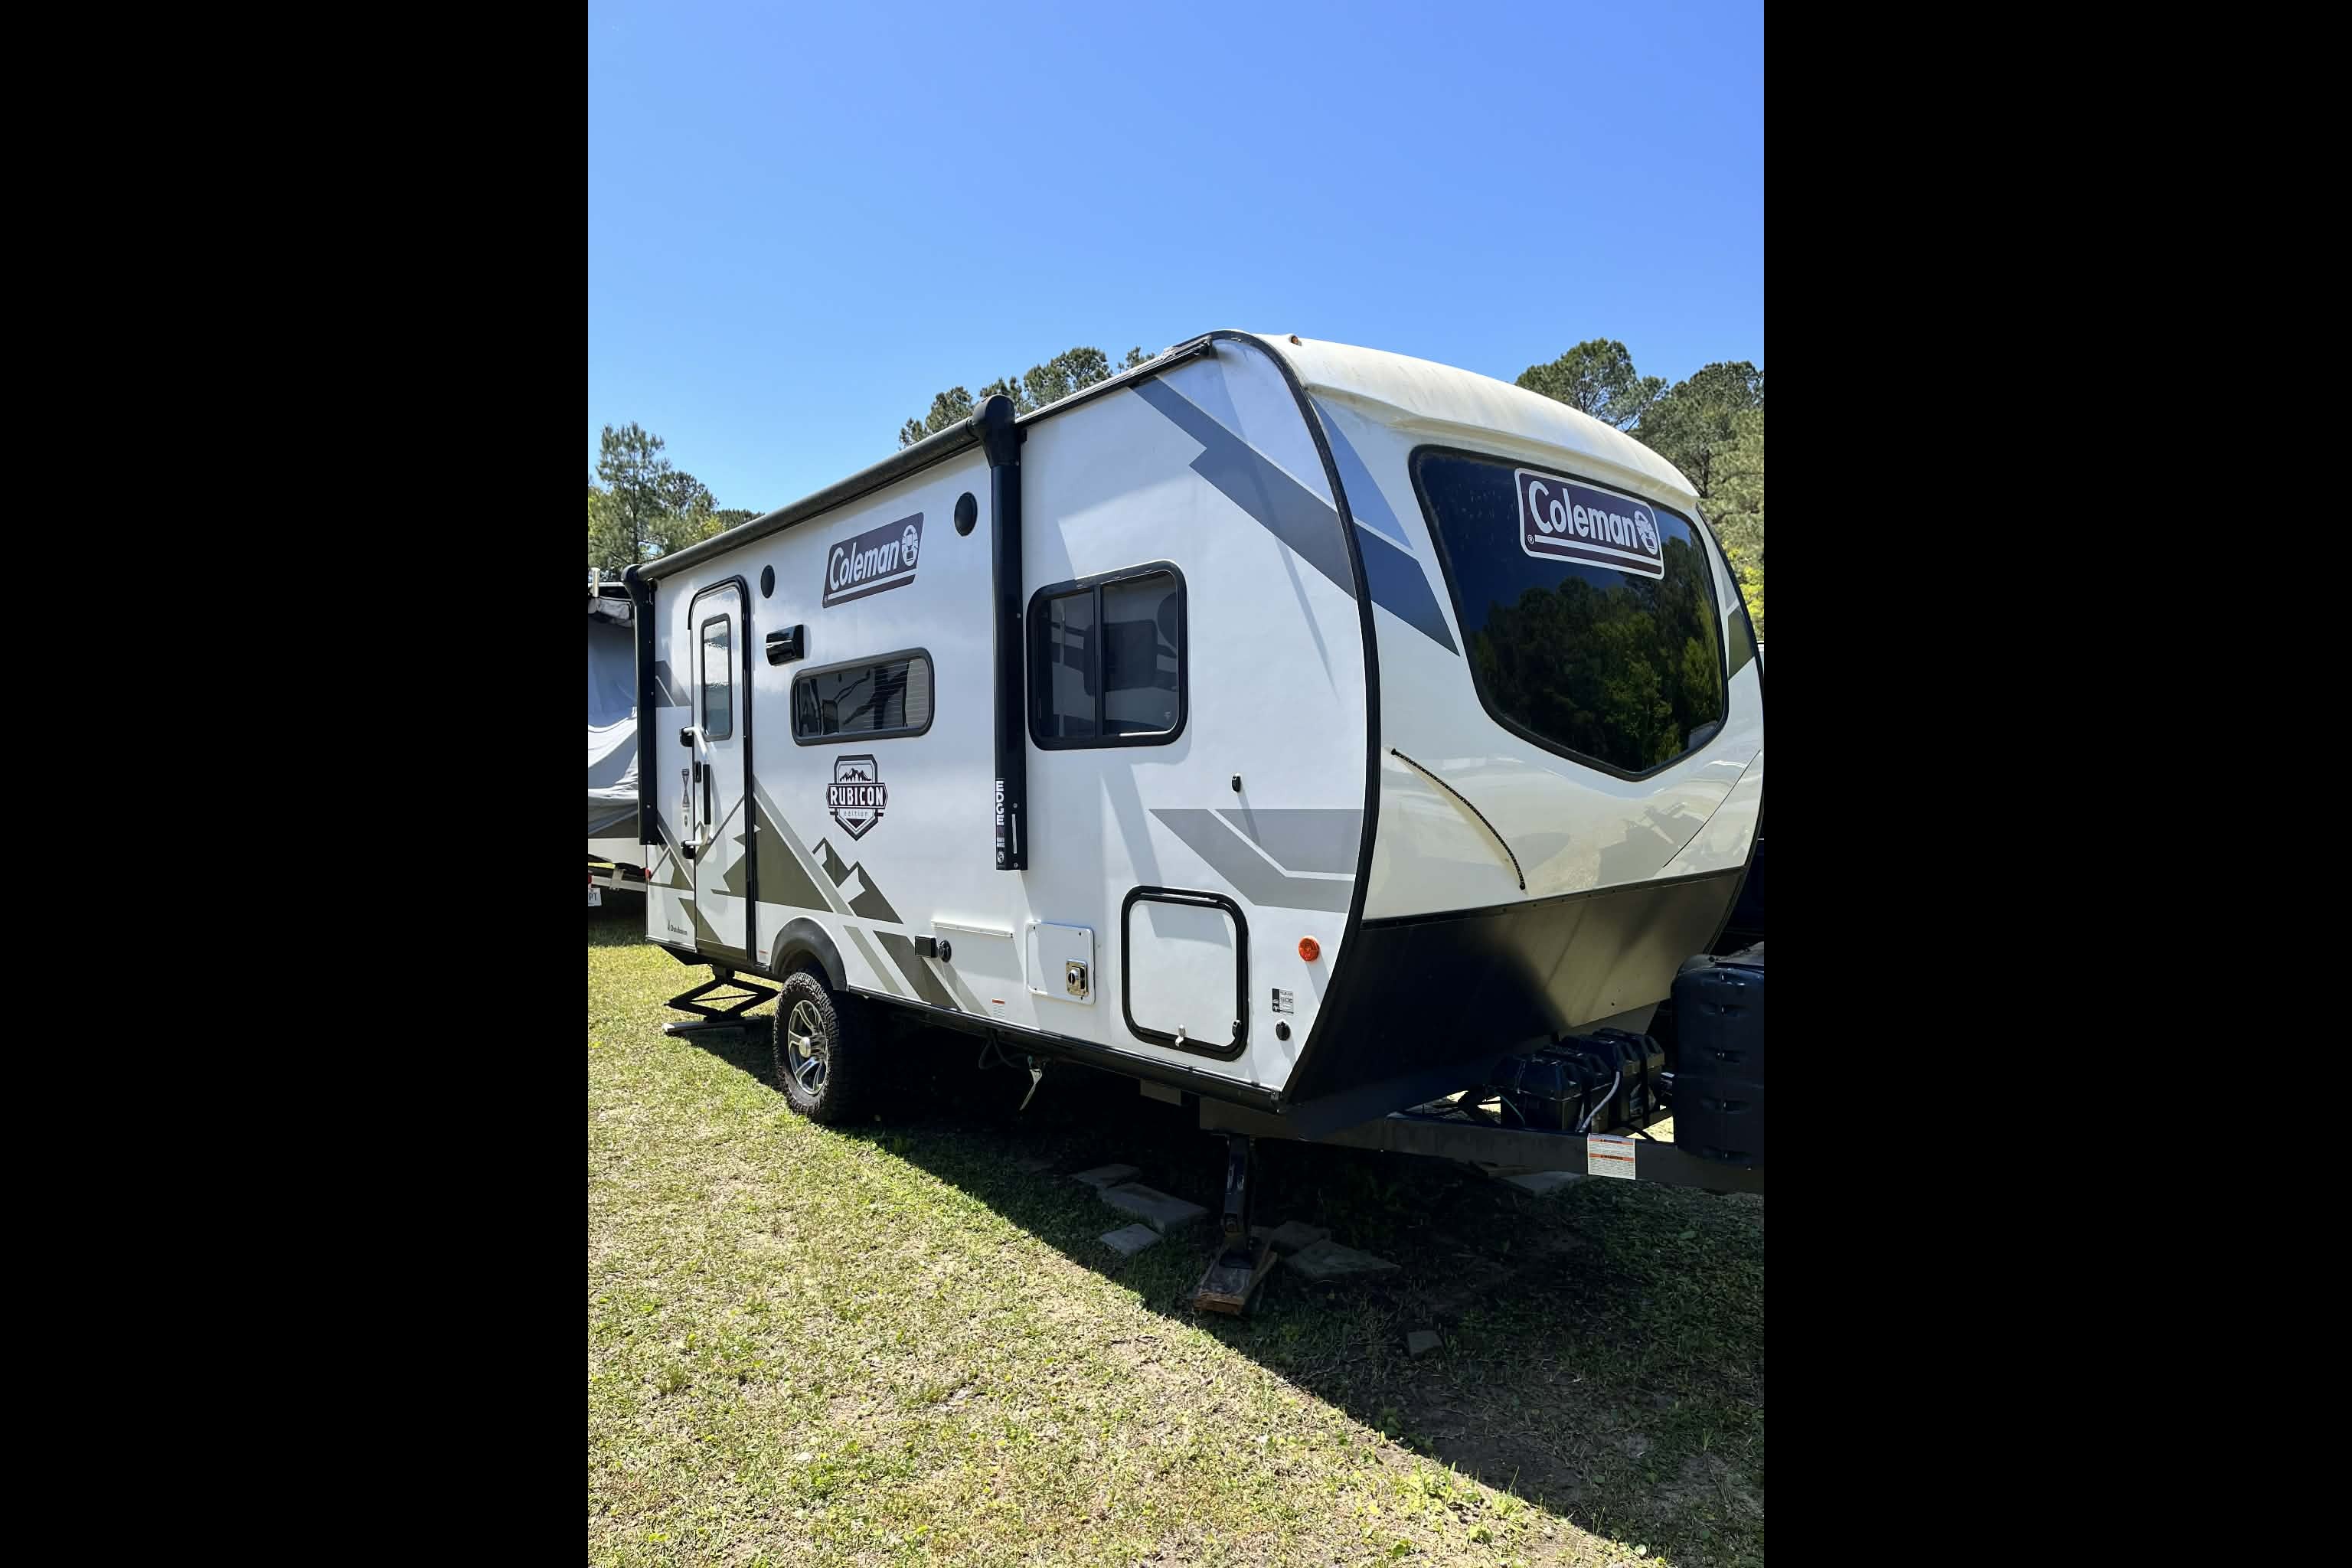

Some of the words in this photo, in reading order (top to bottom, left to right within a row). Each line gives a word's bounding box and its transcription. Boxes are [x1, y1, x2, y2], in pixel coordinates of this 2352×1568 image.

[1529, 480, 1638, 549] Coleman
[829, 540, 900, 591] Coleman
[830, 786, 884, 806] RUBICON
